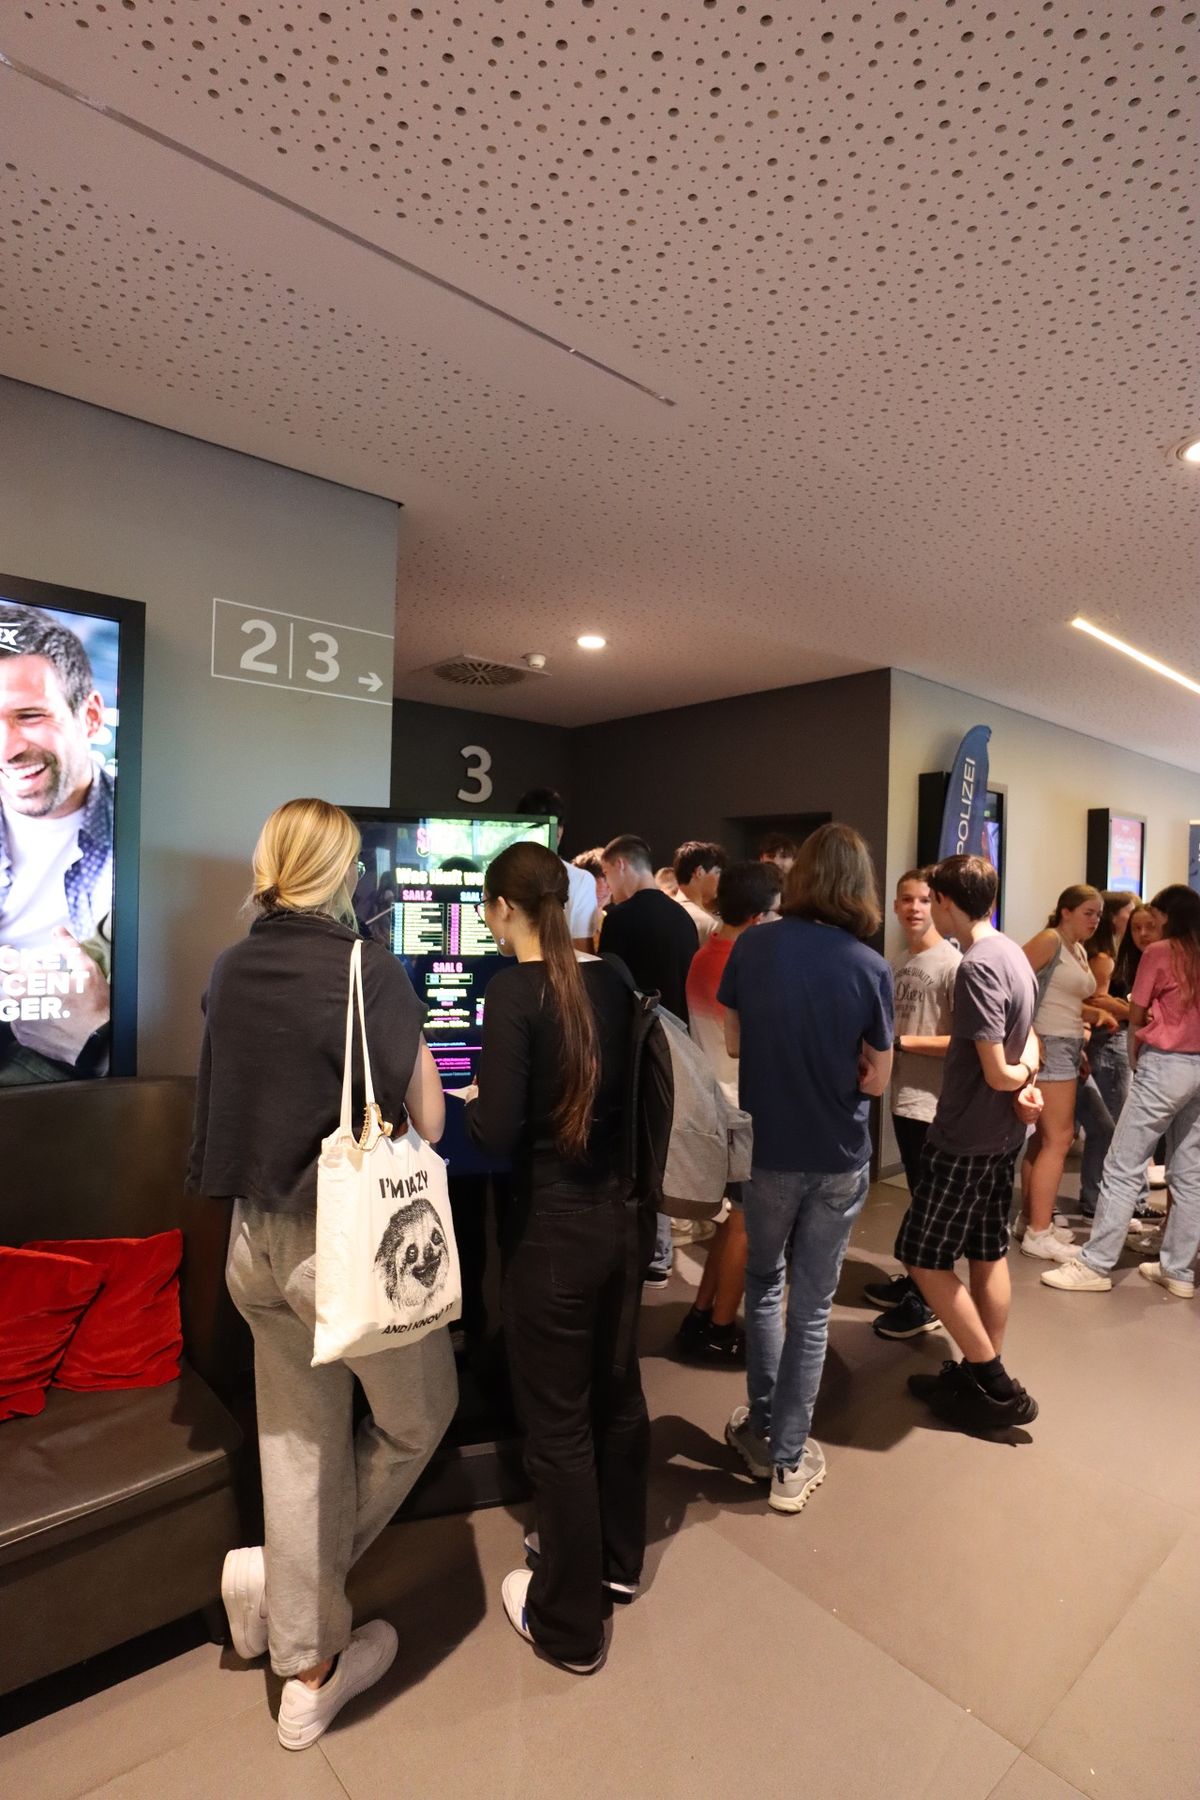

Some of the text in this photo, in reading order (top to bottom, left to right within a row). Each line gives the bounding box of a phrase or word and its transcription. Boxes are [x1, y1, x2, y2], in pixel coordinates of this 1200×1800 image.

[239, 618, 341, 683] 2 3
[457, 745, 493, 803] 3
[402, 889, 433, 901] SAAL 2
[460, 891, 480, 902] SAAL
[433, 962, 463, 973] SAAL 6
[3, 969, 90, 996] CENT
[379, 1178, 405, 1199] I'M
[381, 1324, 407, 1335] AND
